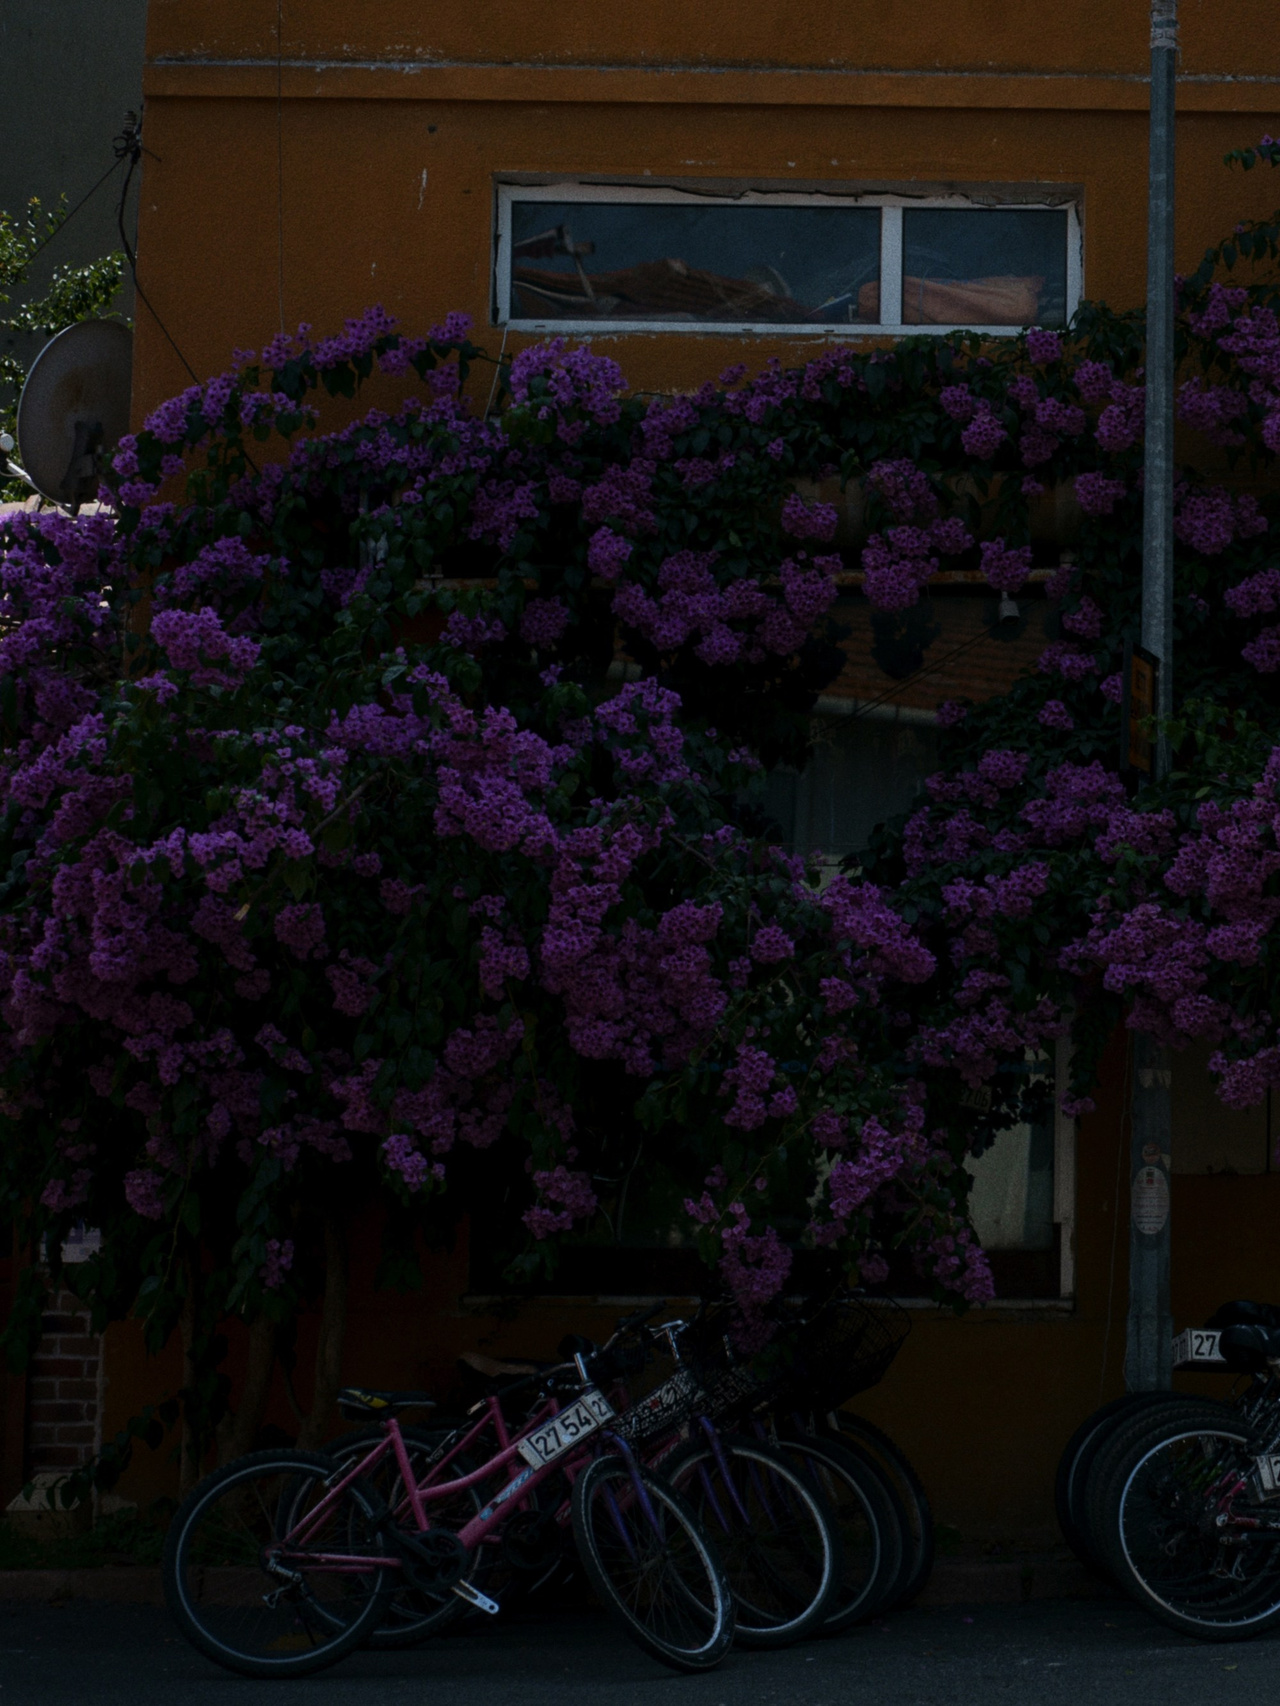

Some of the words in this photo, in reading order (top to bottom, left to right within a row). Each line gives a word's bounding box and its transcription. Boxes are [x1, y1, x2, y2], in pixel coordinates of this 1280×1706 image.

[1194, 1334, 1216, 1357] 27
[535, 1426, 562, 1456] 27
[561, 1408, 592, 1436] 54
